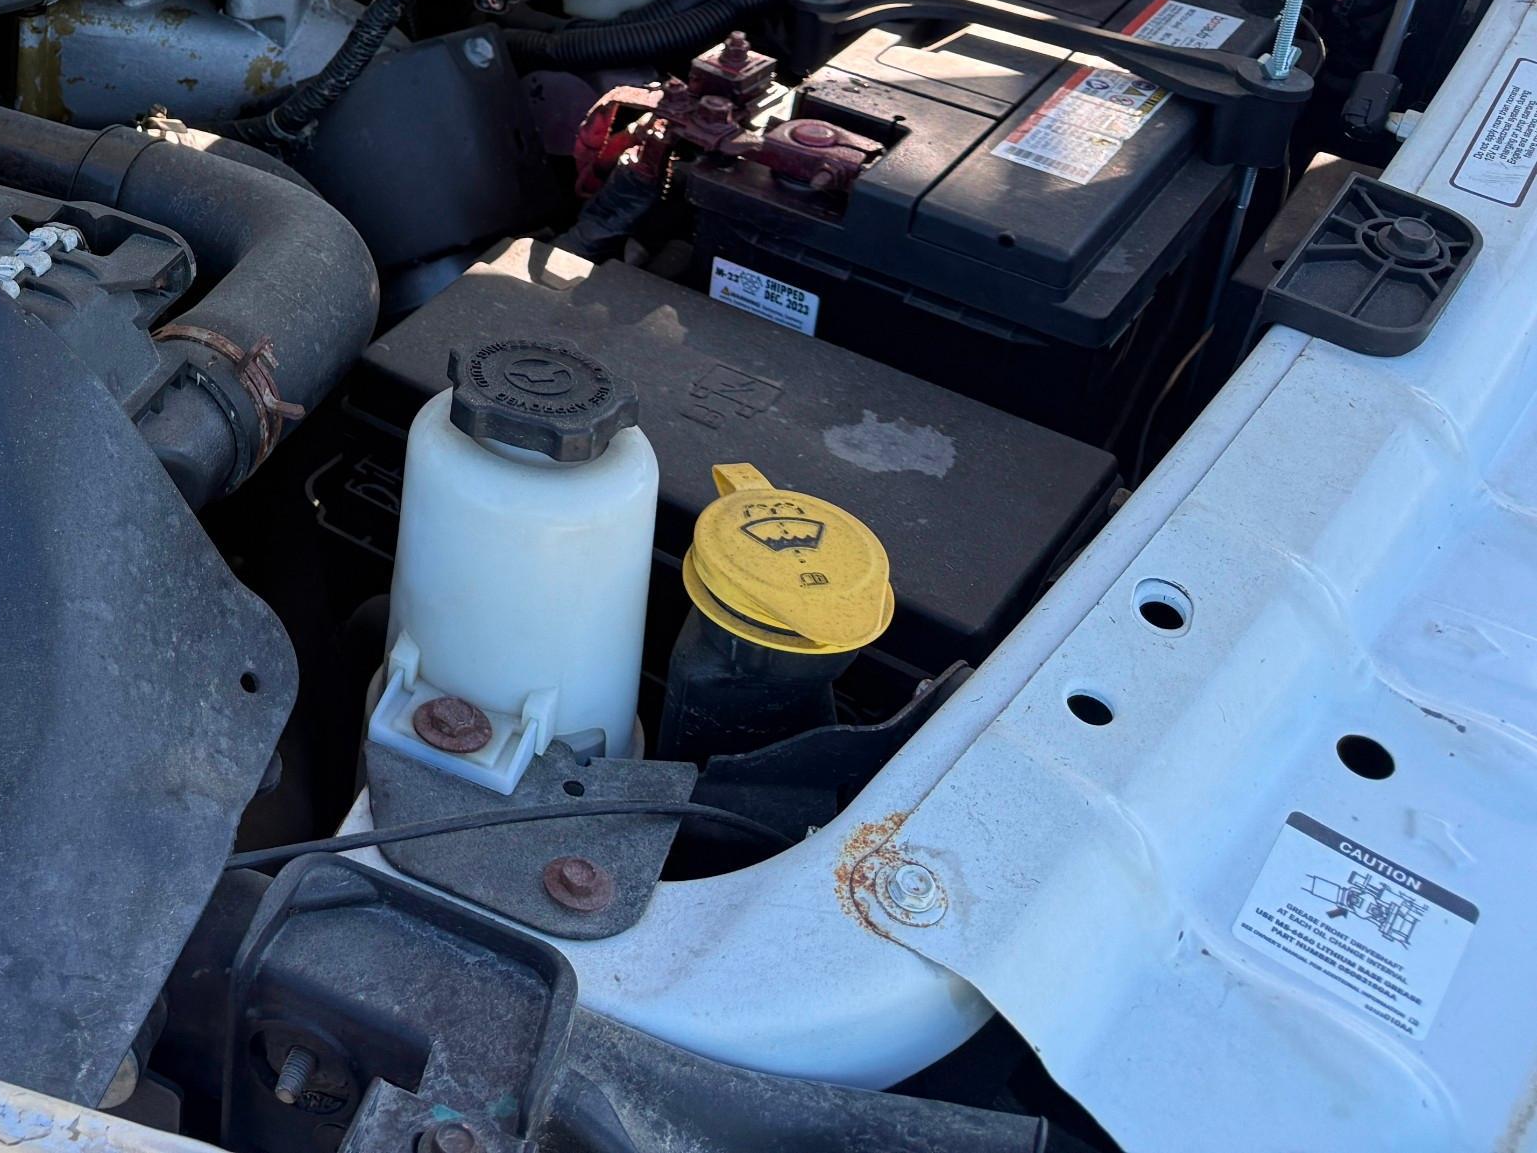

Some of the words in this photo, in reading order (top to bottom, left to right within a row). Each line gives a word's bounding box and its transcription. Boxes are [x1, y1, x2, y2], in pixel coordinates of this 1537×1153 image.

[1484, 151, 1497, 161] 12V
[1496, 121, 1513, 144] electrical
[1508, 104, 1522, 123] system
[1517, 89, 1532, 105] during
[1485, 129, 1498, 142] apply
[1492, 115, 1505, 129] more
[1499, 104, 1510, 117] than
[1505, 85, 1521, 105] nominal
[1499, 137, 1517, 160] charging
[1516, 119, 1529, 133] jump
[1506, 146, 1523, 165] Engine
[763, 289, 783, 307] DEC.
[785, 297, 810, 316] 2023
[764, 278, 806, 303] SHIPPED
[1337, 840, 1424, 892] CAUTION
[1255, 907, 1275, 922] USE
[1316, 941, 1357, 969] LITHIUM
[1357, 965, 1384, 983] BASE
[1383, 979, 1423, 1007] GREASE
[1270, 926, 1296, 944] PART
[1295, 939, 1337, 968] NUMBER
[1276, 907, 1289, 917] AT
[1288, 913, 1313, 931] EACH
[1313, 927, 1327, 940] OIL
[1328, 936, 1365, 961] CHANGE
[1365, 956, 1408, 986] INTERVAL
[1286, 902, 1319, 926] GREASE
[1319, 921, 1350, 942] FRONT
[1349, 938, 1405, 972] DRIVESHAFT
